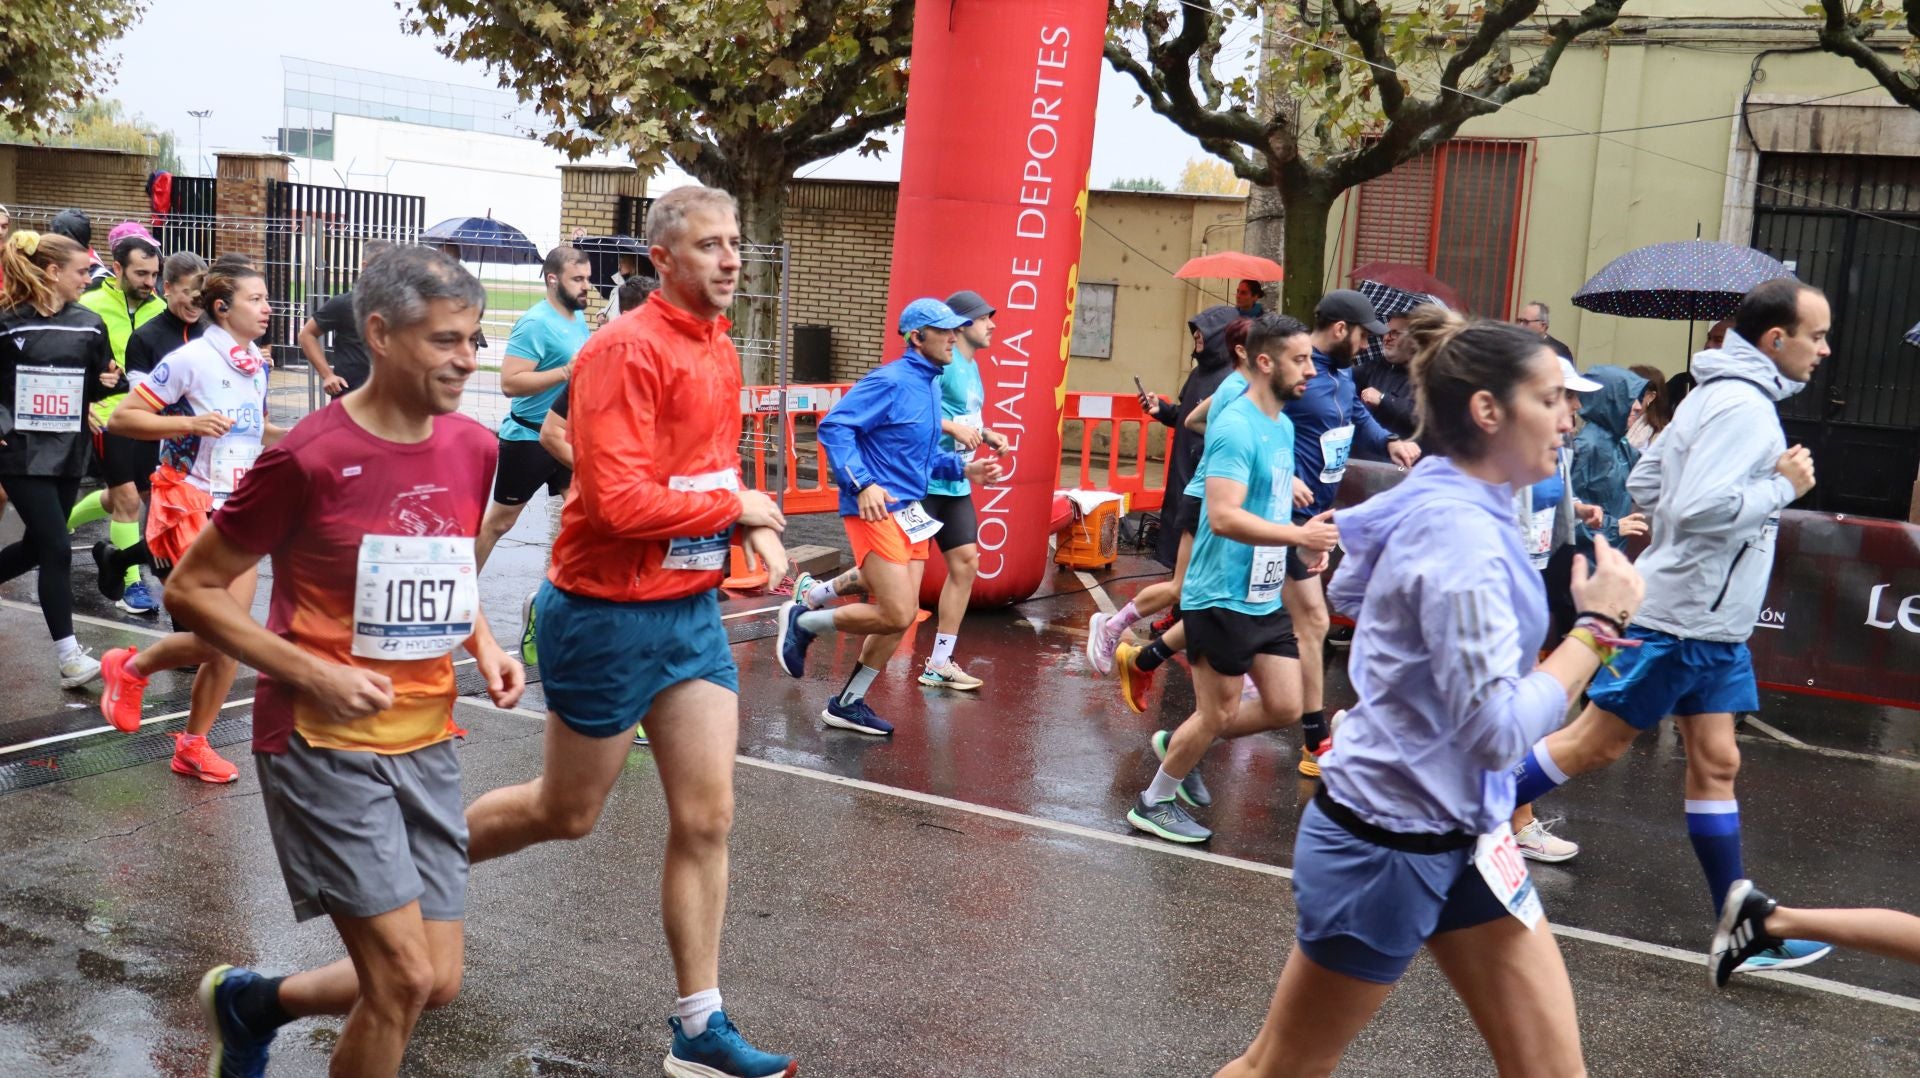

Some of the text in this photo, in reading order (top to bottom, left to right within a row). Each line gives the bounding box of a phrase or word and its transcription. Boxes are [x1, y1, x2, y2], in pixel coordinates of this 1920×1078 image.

[1017, 26, 1070, 239] DEPORTES
[1007, 257, 1043, 310] DE
[33, 394, 70, 415] 905
[386, 579, 456, 623] 1067
[1760, 606, 1787, 624] ÓN
